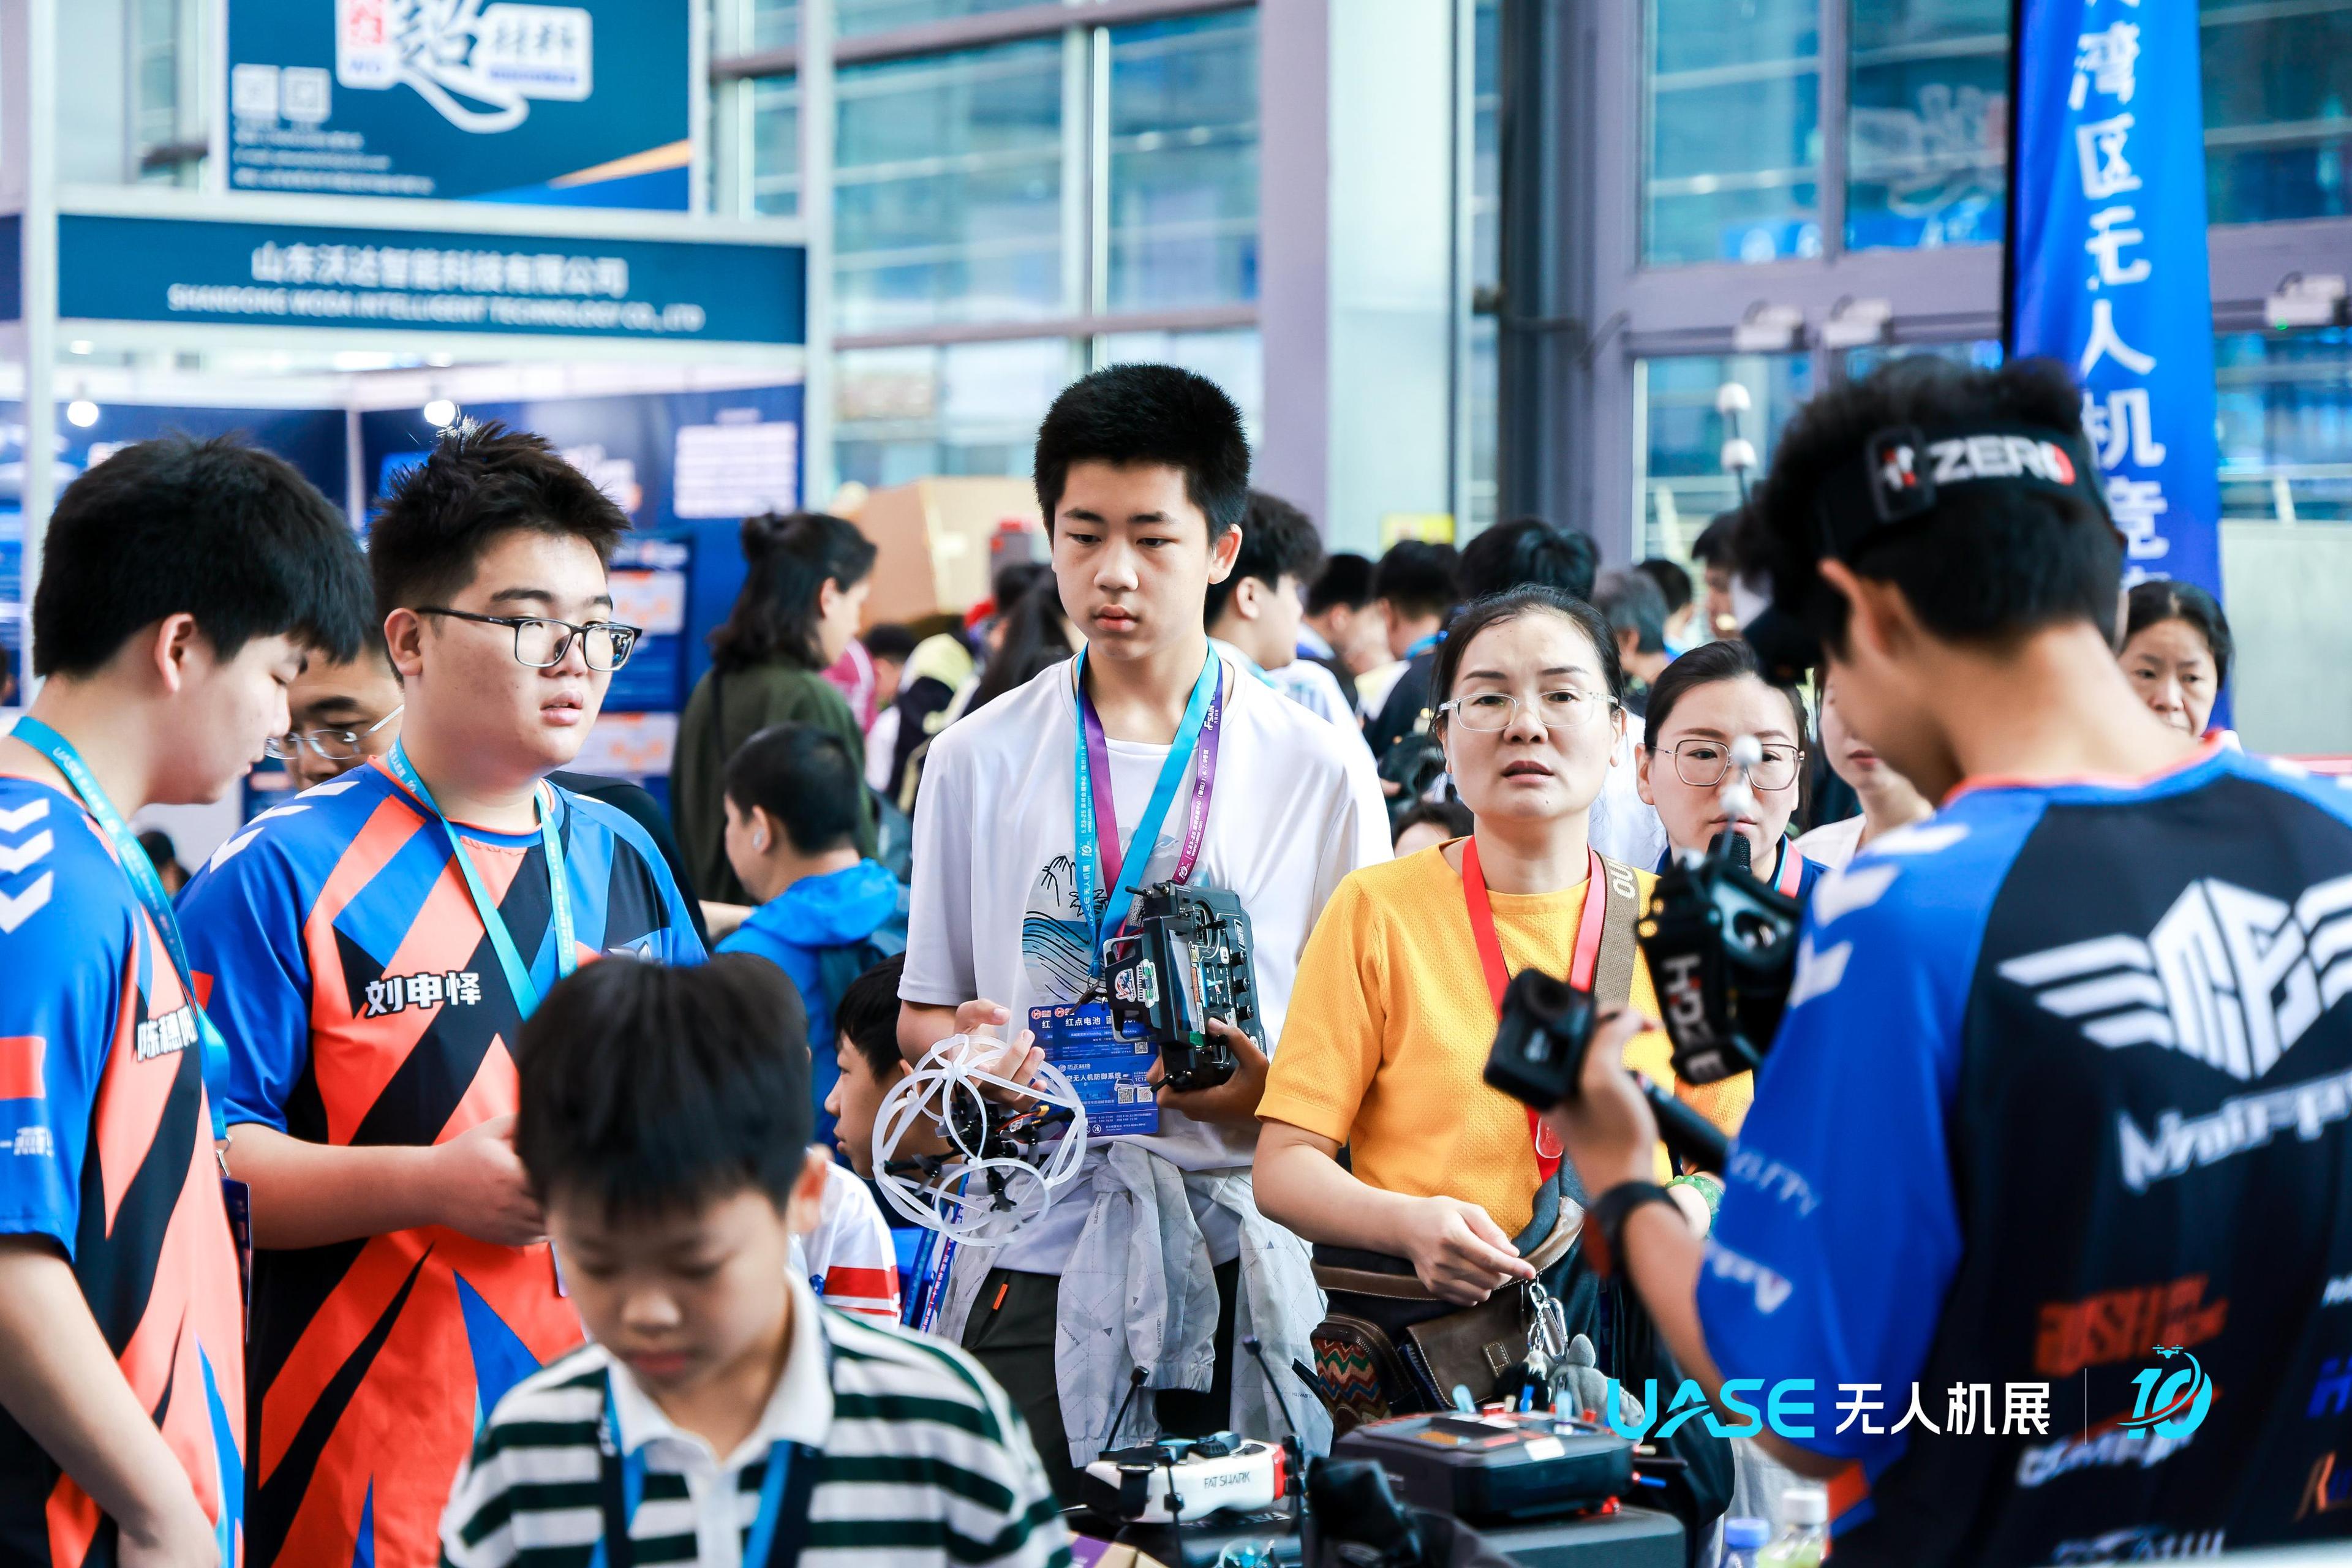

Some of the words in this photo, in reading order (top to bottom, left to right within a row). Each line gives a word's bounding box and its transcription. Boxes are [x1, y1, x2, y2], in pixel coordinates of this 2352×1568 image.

[2067, 0, 2171, 582] 湾区无人机竞
[1065, 1017, 1101, 1027] 红点电池
[1061, 1323, 1080, 1346] ELEVATION
[1204, 1477, 1218, 1489] FAT
